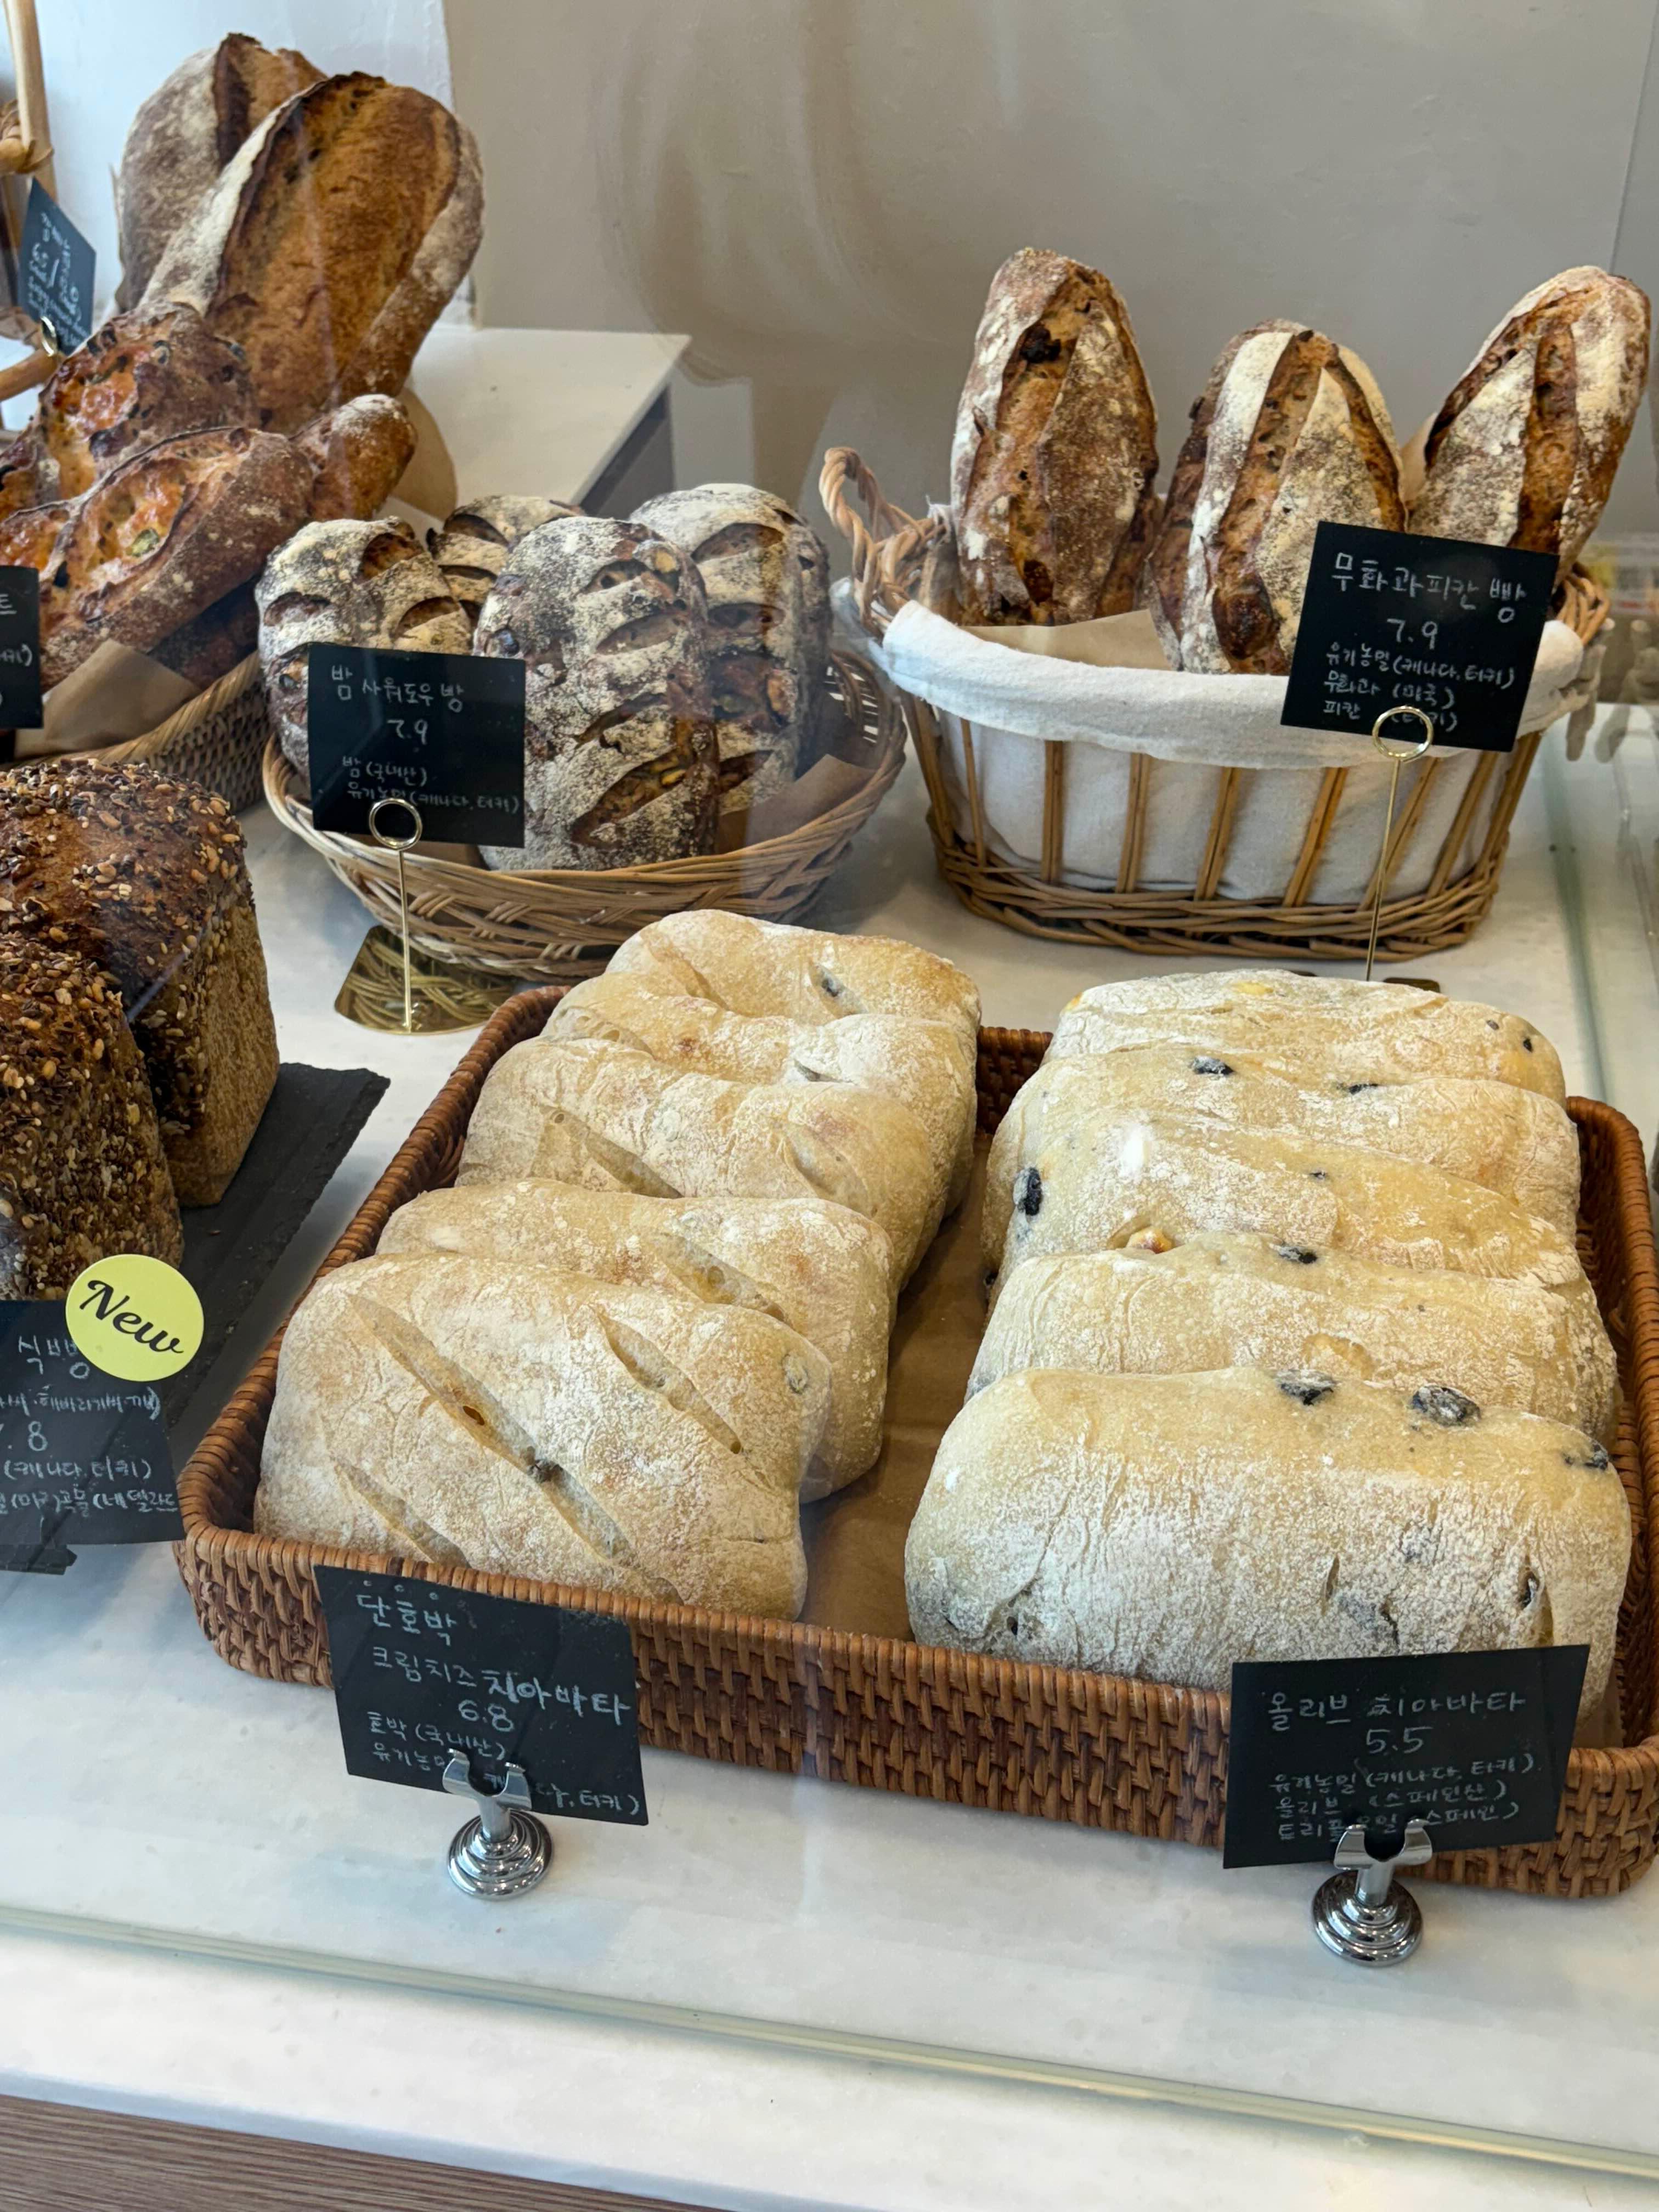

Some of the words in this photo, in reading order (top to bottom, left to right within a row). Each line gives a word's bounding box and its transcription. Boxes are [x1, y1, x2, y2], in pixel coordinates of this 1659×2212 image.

[1489, 577, 1527, 623] 빵
[1387, 618, 1438, 650] 7.9
[331, 664, 354, 701] 밤
[1324, 670, 1381, 696] 무화과
[1323, 699, 1362, 719] 피칸
[387, 718, 429, 745] 7.9
[79, 1279, 185, 1355] New
[356, 1594, 458, 1646] 단호박
[458, 1699, 515, 1732] 6.8
[1268, 1692, 1351, 1731] 올리브
[1367, 1691, 1526, 1717] 치아바타
[1365, 1726, 1434, 1754] 5.5
